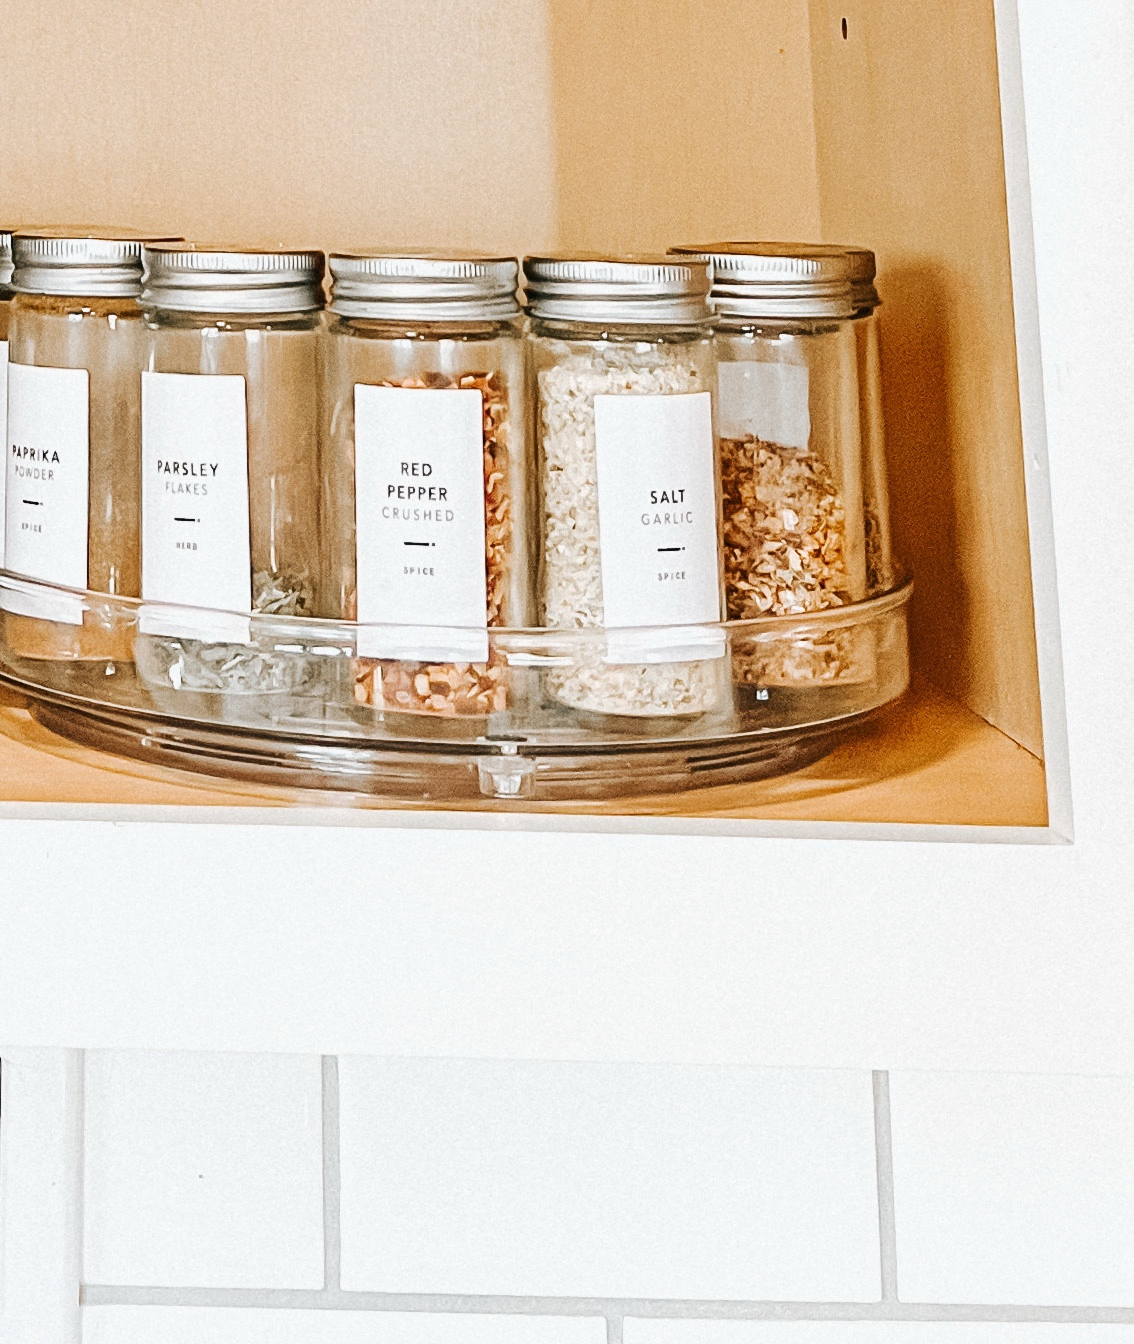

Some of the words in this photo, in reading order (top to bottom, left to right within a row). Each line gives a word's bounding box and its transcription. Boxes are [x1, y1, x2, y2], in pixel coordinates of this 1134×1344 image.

[12, 444, 60, 464] PAPRIKA
[14, 465, 54, 481] POWDER
[157, 459, 220, 478] PARSLEY
[400, 463, 433, 477] RED
[165, 481, 209, 497] FLAKES
[387, 485, 448, 502] PEPPER
[650, 489, 686, 505] SALT
[381, 506, 455, 523] CRUSHED
[640, 510, 694, 526] GARLIC
[175, 541, 199, 551] HERB
[403, 566, 435, 577] SPICE
[657, 570, 687, 581] SPICE
